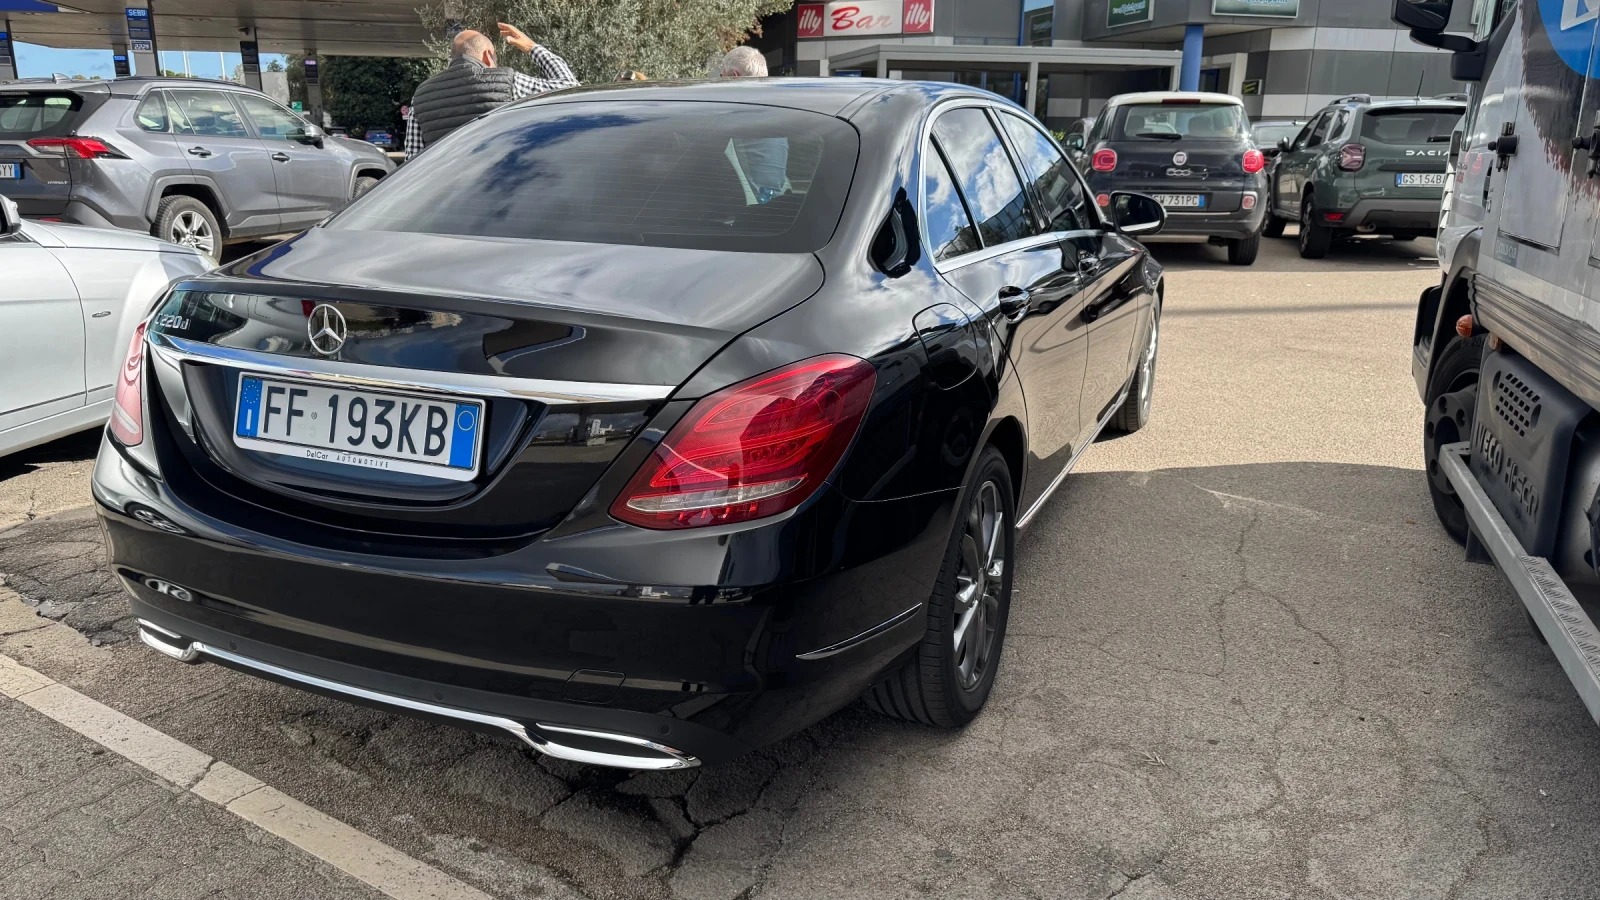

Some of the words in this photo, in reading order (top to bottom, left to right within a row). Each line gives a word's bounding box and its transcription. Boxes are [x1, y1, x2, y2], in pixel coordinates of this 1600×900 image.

[799, 10, 822, 33] illy
[831, 7, 893, 30] Bar
[906, 3, 930, 29] illy
[1402, 174, 1415, 184] GS
[1168, 195, 1197, 205] 731PC
[263, 385, 308, 436] FF
[328, 394, 449, 457] 193KB
[306, 449, 329, 460] DelCar
[336, 454, 389, 469] AUTOMOTIVE
[1473, 421, 1504, 475] IVECO
